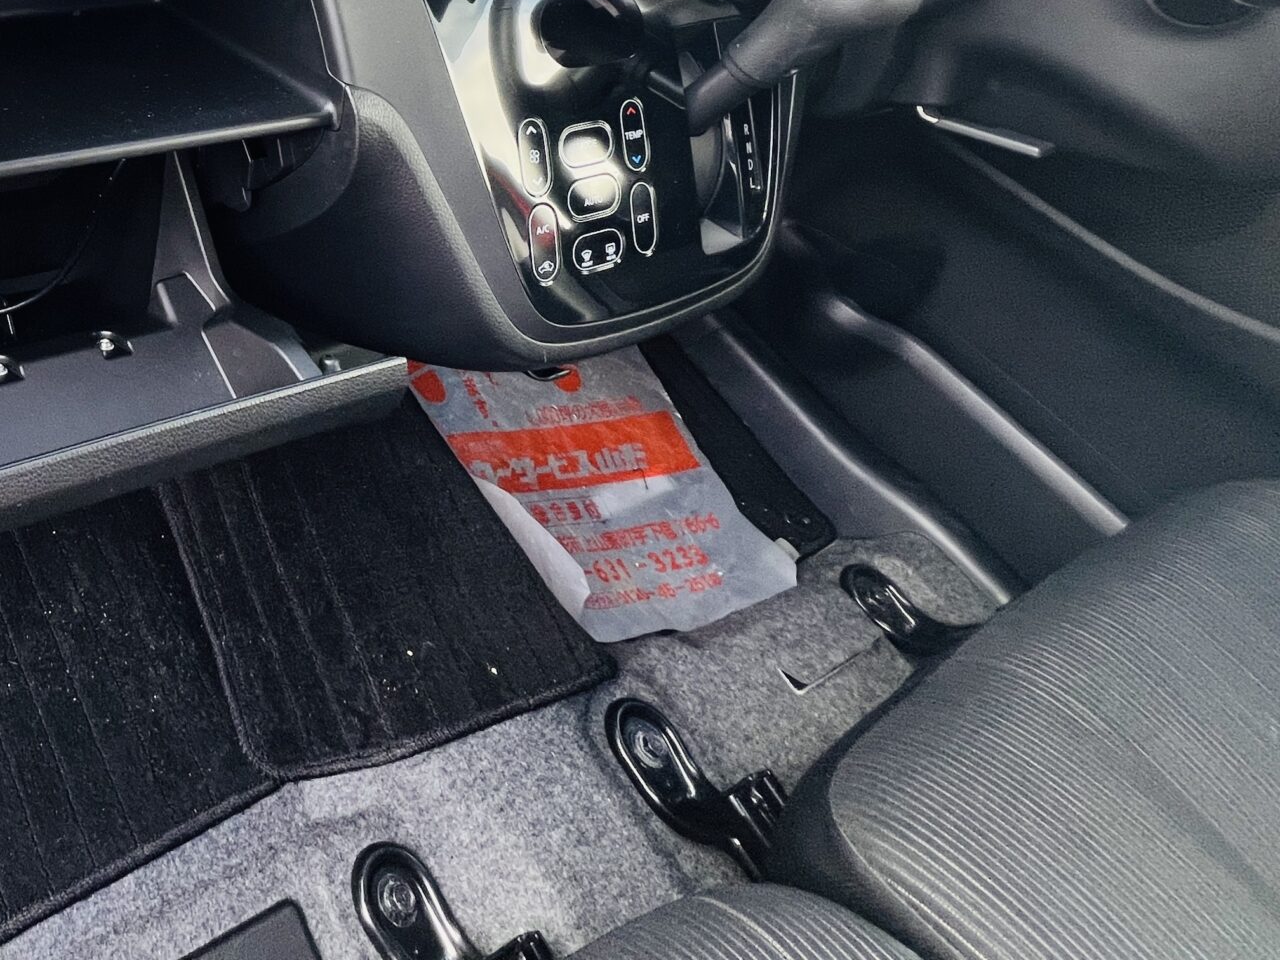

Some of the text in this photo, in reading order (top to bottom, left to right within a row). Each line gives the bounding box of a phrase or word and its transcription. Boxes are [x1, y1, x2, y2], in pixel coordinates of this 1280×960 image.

[624, 129, 643, 141] TEMP
[743, 123, 750, 135] R
[748, 159, 753, 171] D
[636, 213, 650, 224] OFF
[536, 224, 550, 236] A/C
